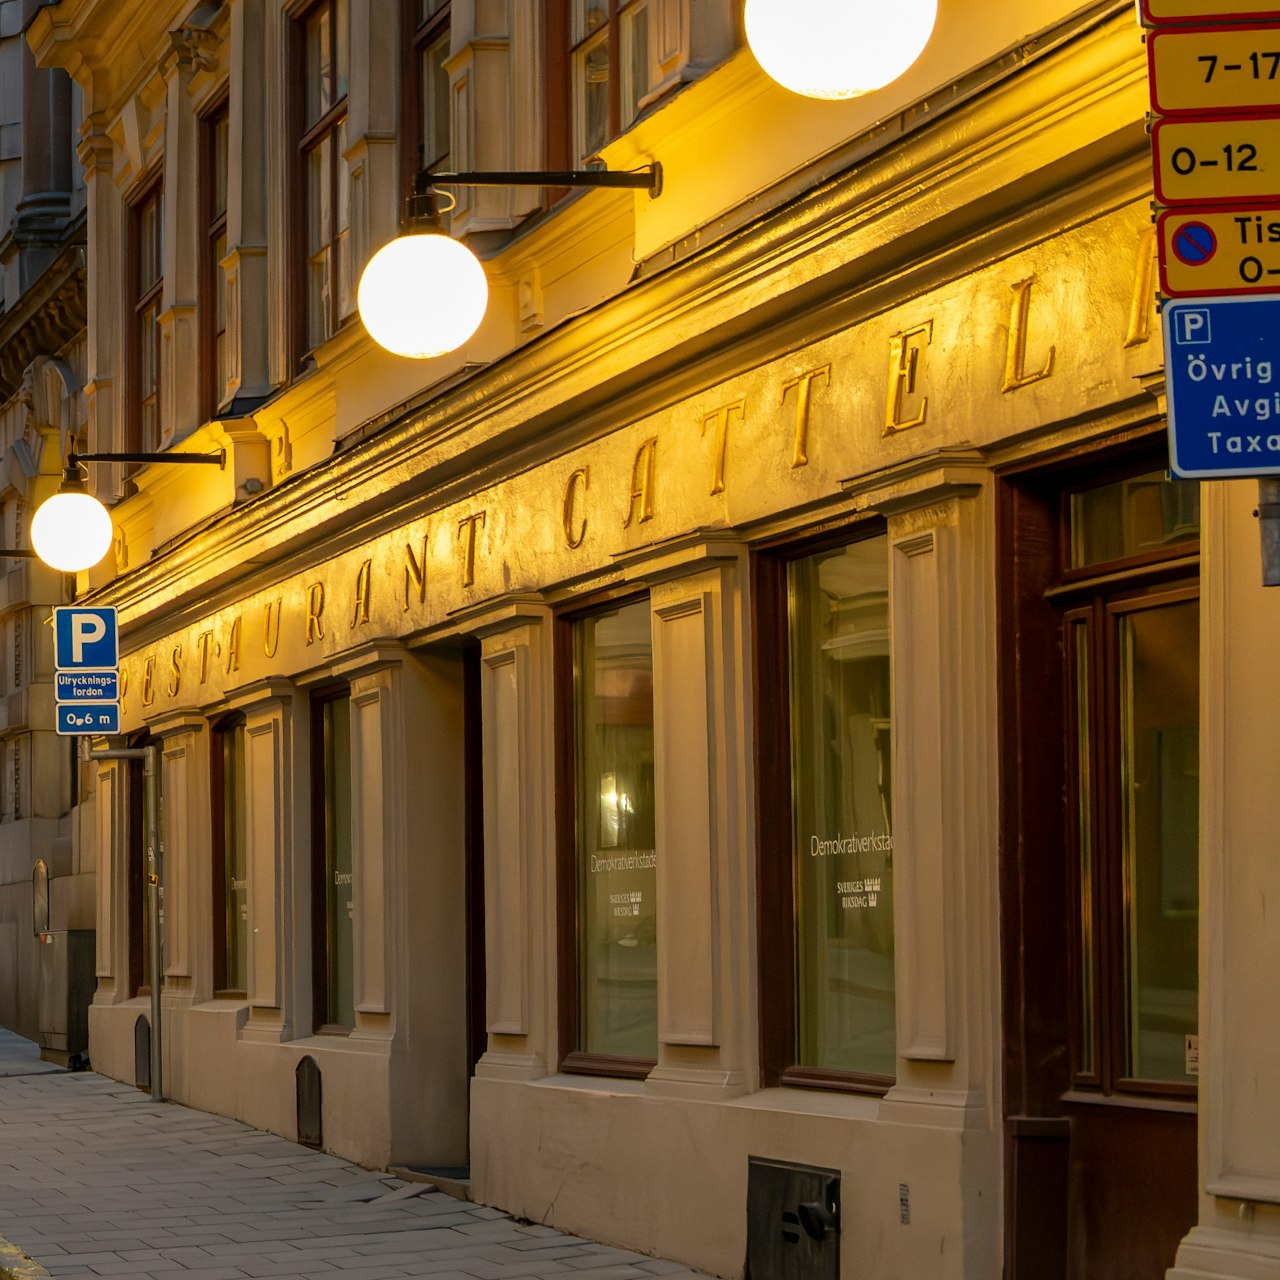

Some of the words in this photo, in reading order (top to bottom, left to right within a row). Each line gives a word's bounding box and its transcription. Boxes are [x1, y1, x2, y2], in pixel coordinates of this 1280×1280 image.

[1198, 52, 1280, 83] 7-17
[1171, 143, 1257, 175] 0-12
[1234, 216, 1280, 244] Tis
[1184, 313, 1204, 340] P
[1188, 353, 1272, 384] Övrig
[72, 613, 106, 663] P
[73, 687, 103, 696] fordon
[99, 715, 111, 725] m
